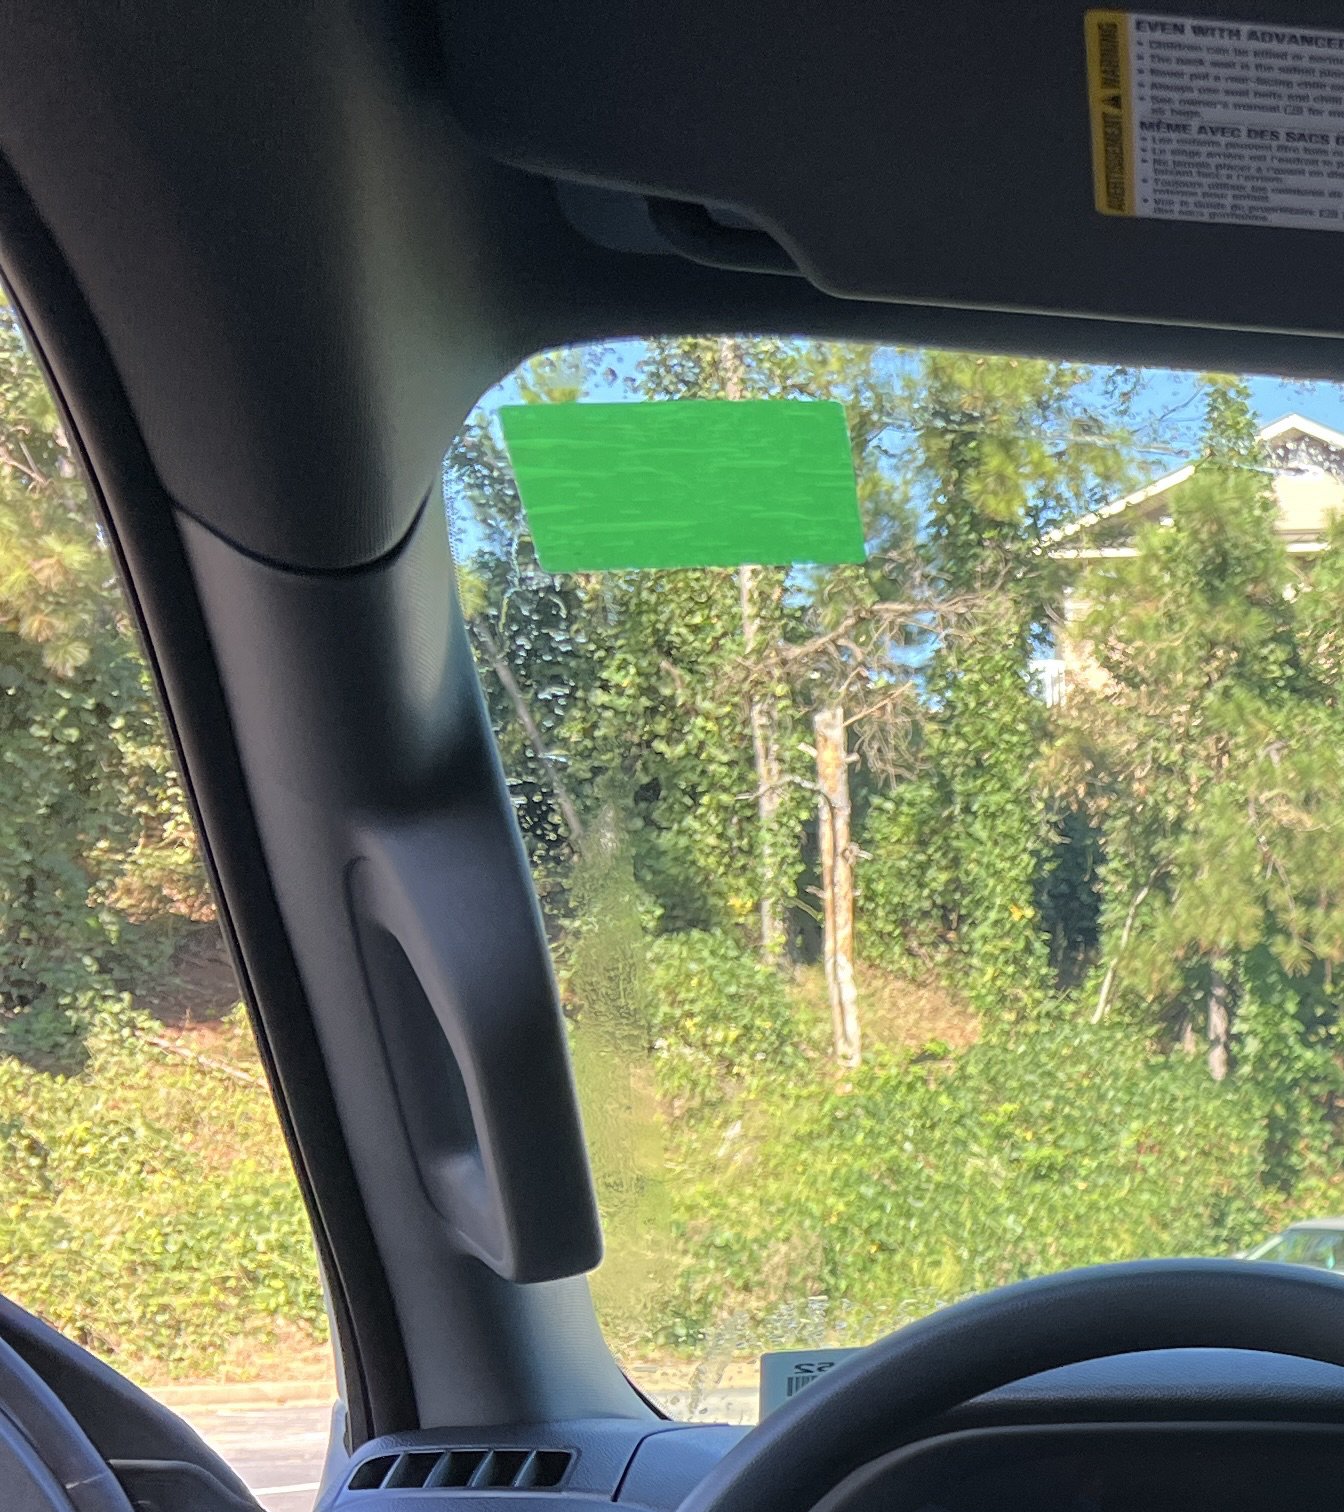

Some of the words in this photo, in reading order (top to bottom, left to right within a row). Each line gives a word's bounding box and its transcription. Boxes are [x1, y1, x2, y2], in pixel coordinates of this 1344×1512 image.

[1136, 20, 1185, 36] EVEN
[1192, 24, 1241, 41] WITH
[1197, 124, 1242, 139] AVEC
[1246, 128, 1280, 141] DES
[1285, 131, 1330, 146] SACS
